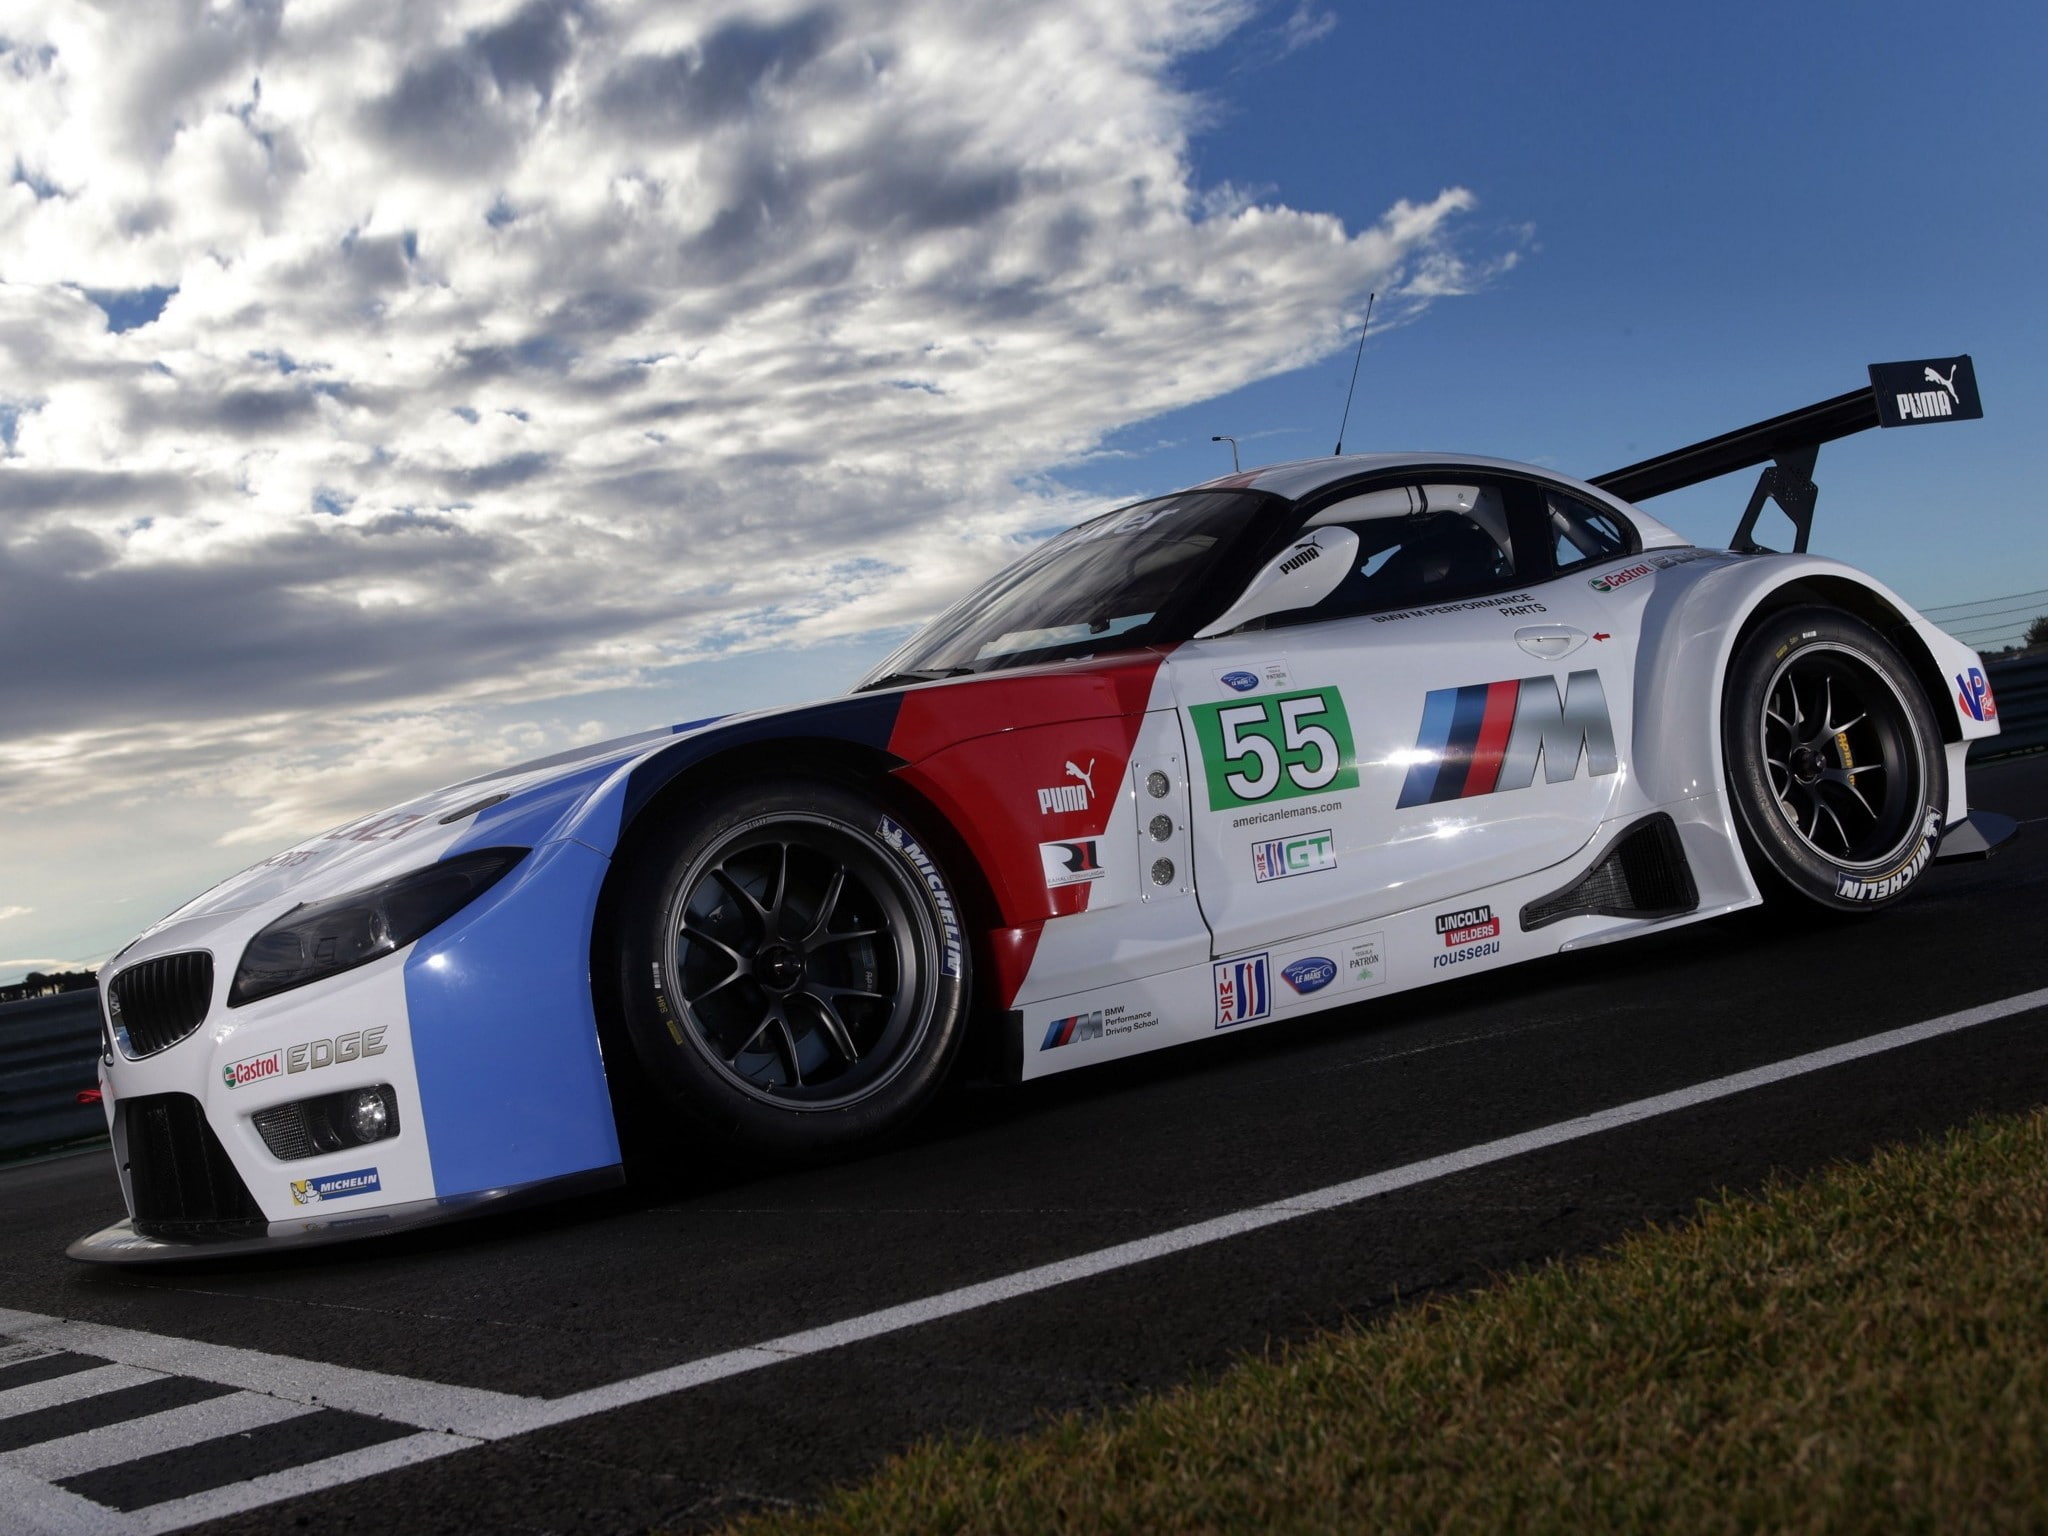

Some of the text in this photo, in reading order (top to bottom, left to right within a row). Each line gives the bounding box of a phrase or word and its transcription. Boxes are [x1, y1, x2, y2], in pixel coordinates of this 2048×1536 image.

[1896, 390, 1952, 420] PUMA
[1279, 547, 1320, 575] PUMA
[1604, 563, 1653, 587] Castrol
[1371, 593, 1535, 623] BMW M PERFORMANCE
[1498, 603, 1548, 617] PARTS
[1956, 667, 1986, 722] VP
[1217, 694, 1340, 801] 55
[1037, 784, 1088, 815] PUMA
[1232, 801, 1342, 828] americanlemans.com
[1286, 835, 1330, 870] GT
[1839, 838, 1931, 900] MICHELIN
[904, 842, 961, 972] MICHELIN
[1438, 908, 1489, 932] LINCOLN
[1450, 924, 1495, 945] WELDERS
[1349, 953, 1380, 969] PATRÓN
[1433, 940, 1500, 968] rousseau
[1294, 975, 1304, 984] LE
[1219, 967, 1234, 1024] IMSA
[1104, 1005, 1125, 1017] BMW
[1105, 1011, 1152, 1027] Performance
[1105, 1018, 1159, 1037] Driving School
[236, 1024, 388, 1084] Castrol EDGE
[319, 1174, 377, 1193] MICHELIN
